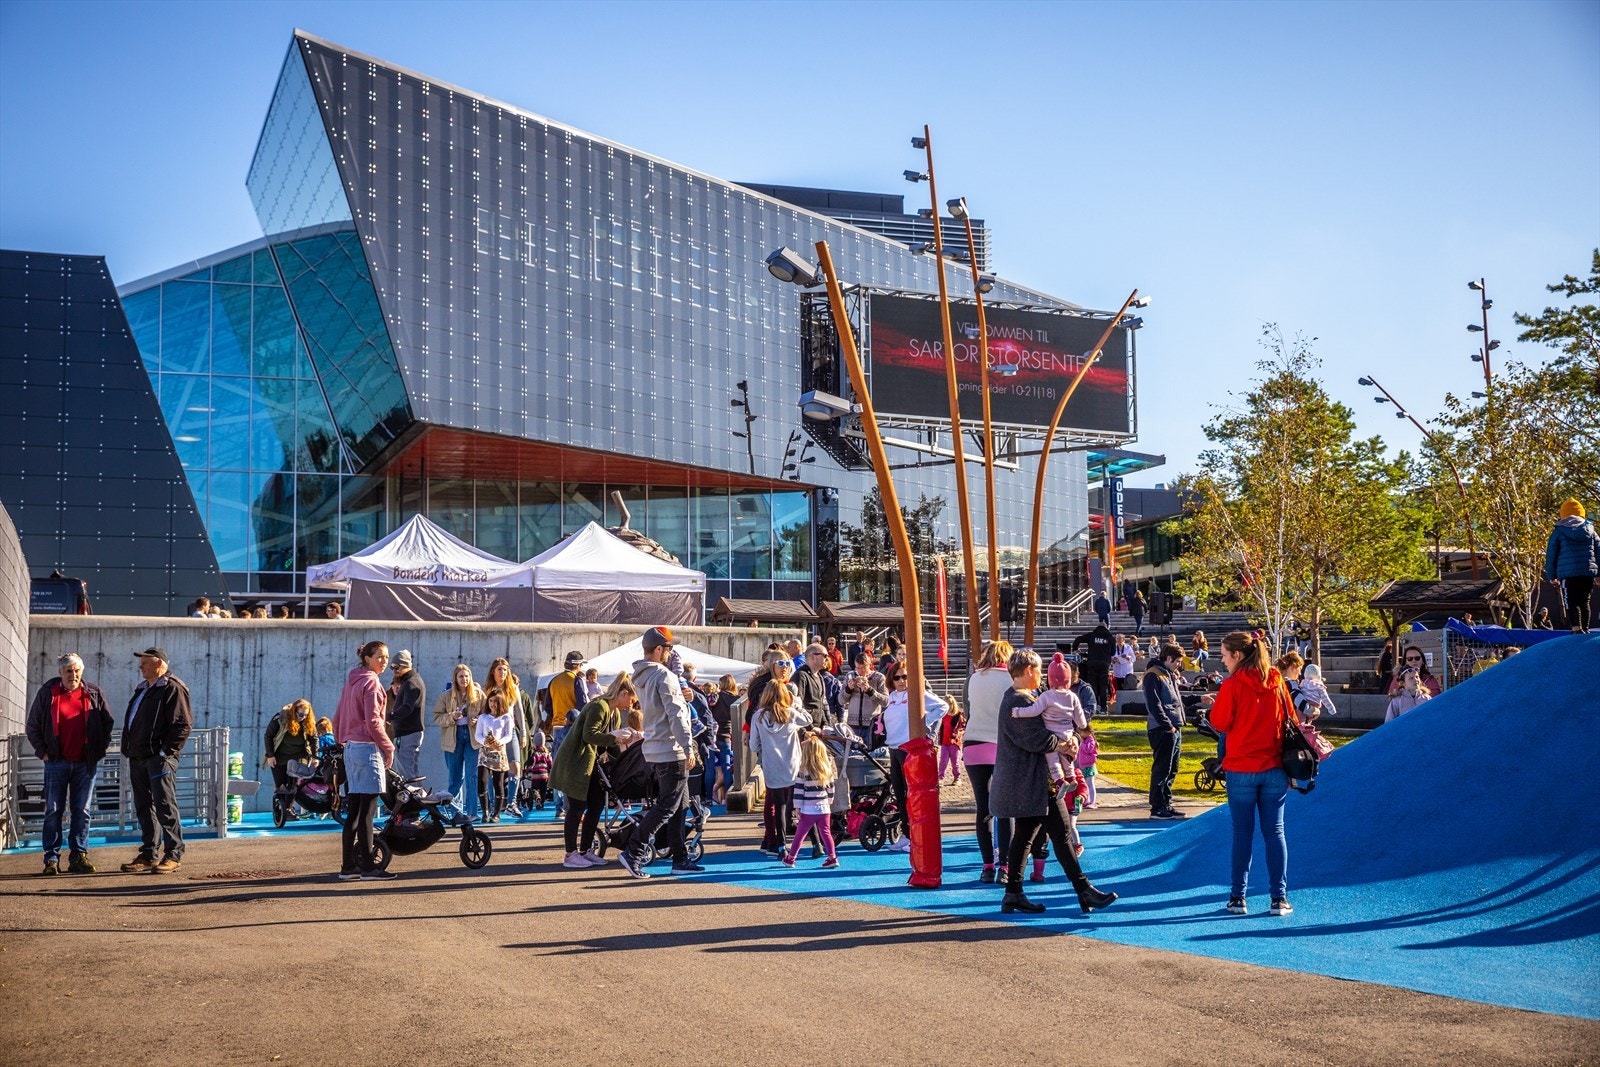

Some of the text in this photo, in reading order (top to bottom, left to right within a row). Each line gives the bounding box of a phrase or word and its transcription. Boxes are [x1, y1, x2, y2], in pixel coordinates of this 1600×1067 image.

[956, 321, 1050, 343] VEOMMEN TIL
[909, 338, 1095, 374] SAROR STORSENTE
[1116, 481, 1125, 540] ODEON
[393, 565, 439, 583] Bondens
